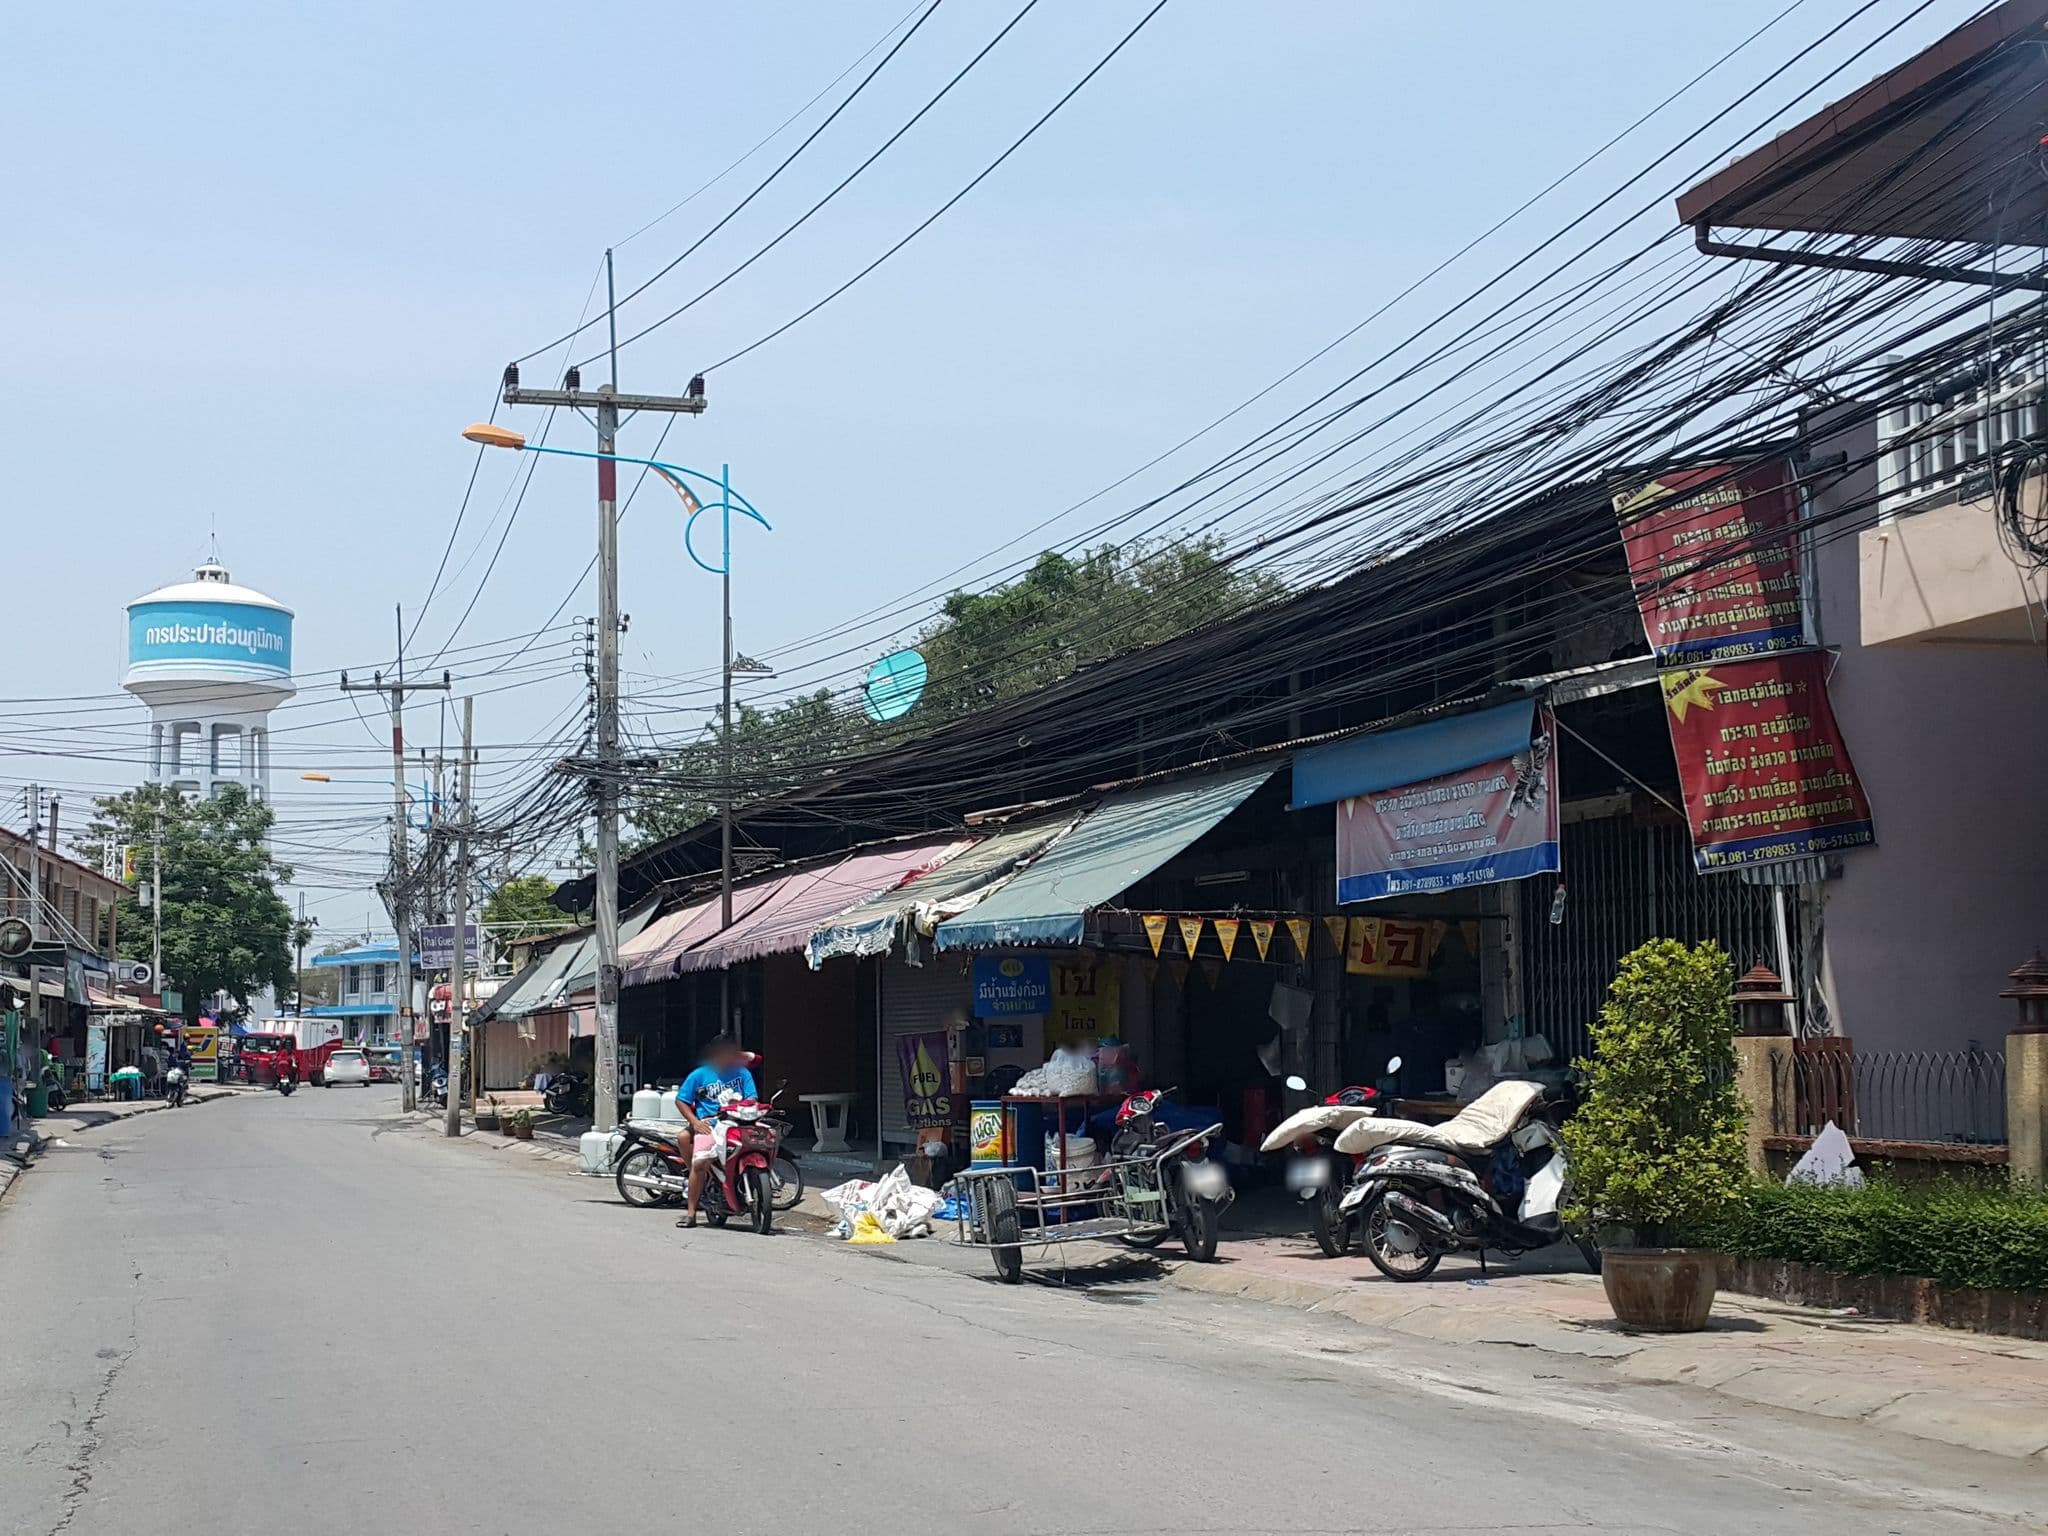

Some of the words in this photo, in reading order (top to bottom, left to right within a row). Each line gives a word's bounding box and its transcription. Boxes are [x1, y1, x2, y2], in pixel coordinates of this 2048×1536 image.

[146, 620, 284, 656] การประปาส่วนภูมิภาค
[1717, 679, 1794, 708] เอกอลูมิเนียม
[1719, 723, 1758, 742] กระจก
[1761, 713, 1811, 743] อลูมิเนียม
[1749, 746, 1787, 776] มุ้งลวด
[1789, 739, 1835, 764] บานเกล็ด
[1702, 784, 1745, 807] บานสวิง
[1749, 772, 1797, 800] บานเลื่อน
[979, 976, 1046, 999] มีน้ำแข็งก้อน
[913, 1072, 939, 1084] FUEL
[906, 1096, 952, 1117] GAS
